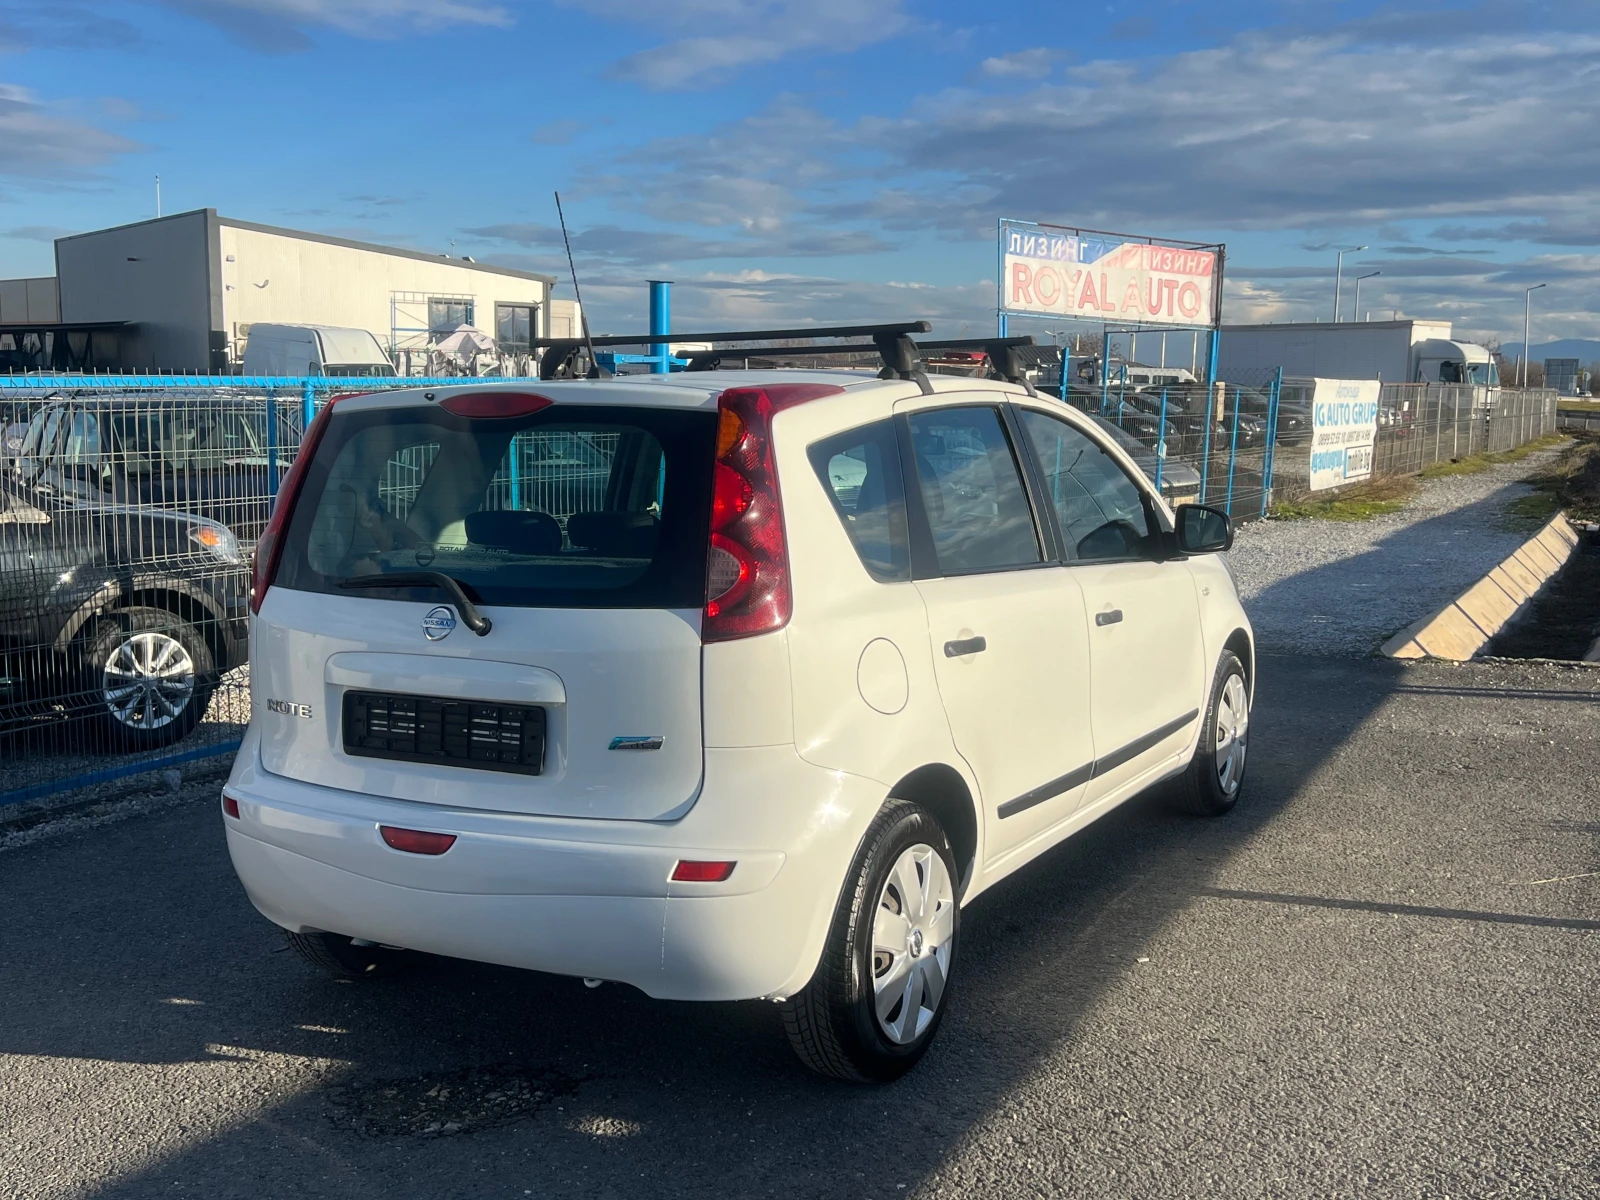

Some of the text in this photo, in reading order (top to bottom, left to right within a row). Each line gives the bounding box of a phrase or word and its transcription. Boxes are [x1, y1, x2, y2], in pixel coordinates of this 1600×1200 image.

[1009, 233, 1088, 261] ЛИЗИНГ
[1012, 262, 1201, 318] ROYAL AUTO
[1314, 402, 1377, 427] IG AUTO GRUP
[424, 619, 450, 627] NISSAN
[266, 698, 313, 718] NOTE
